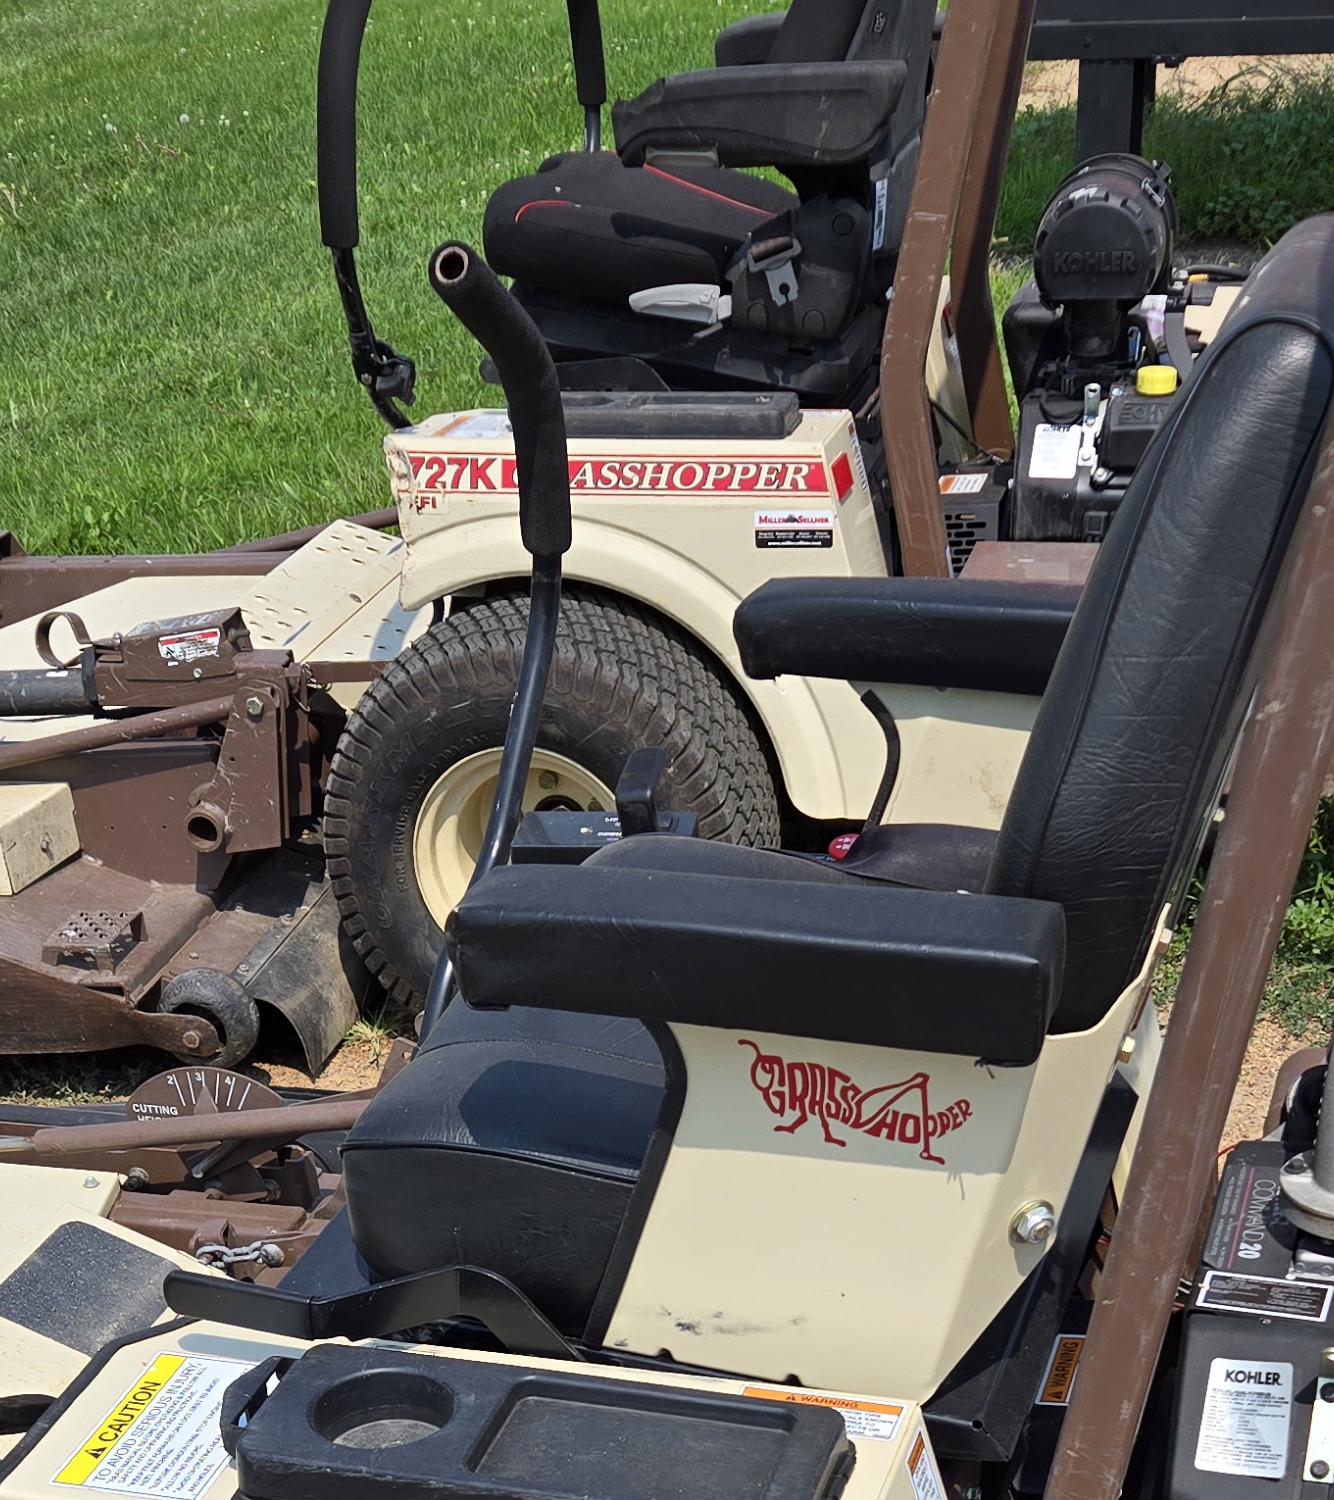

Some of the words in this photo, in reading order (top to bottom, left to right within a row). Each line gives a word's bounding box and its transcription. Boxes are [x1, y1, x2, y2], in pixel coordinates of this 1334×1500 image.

[1053, 250, 1137, 274] KOHLER
[413, 456, 497, 490] 727K
[513, 461, 810, 491] ASSHOPPER
[132, 1103, 179, 1116] CUTTING
[1237, 1242, 1263, 1259] 20
[1049, 1341, 1079, 1388] WARNING
[1224, 1369, 1283, 1386] KOHLER
[95, 1380, 163, 1442] CAUTION
[801, 1395, 858, 1409] WARNING
[91, 1468, 113, 1482] TO
[103, 1438, 139, 1467] AVOID
[129, 1395, 174, 1436] SERIOUS
[163, 1362, 202, 1394] INJURY,
